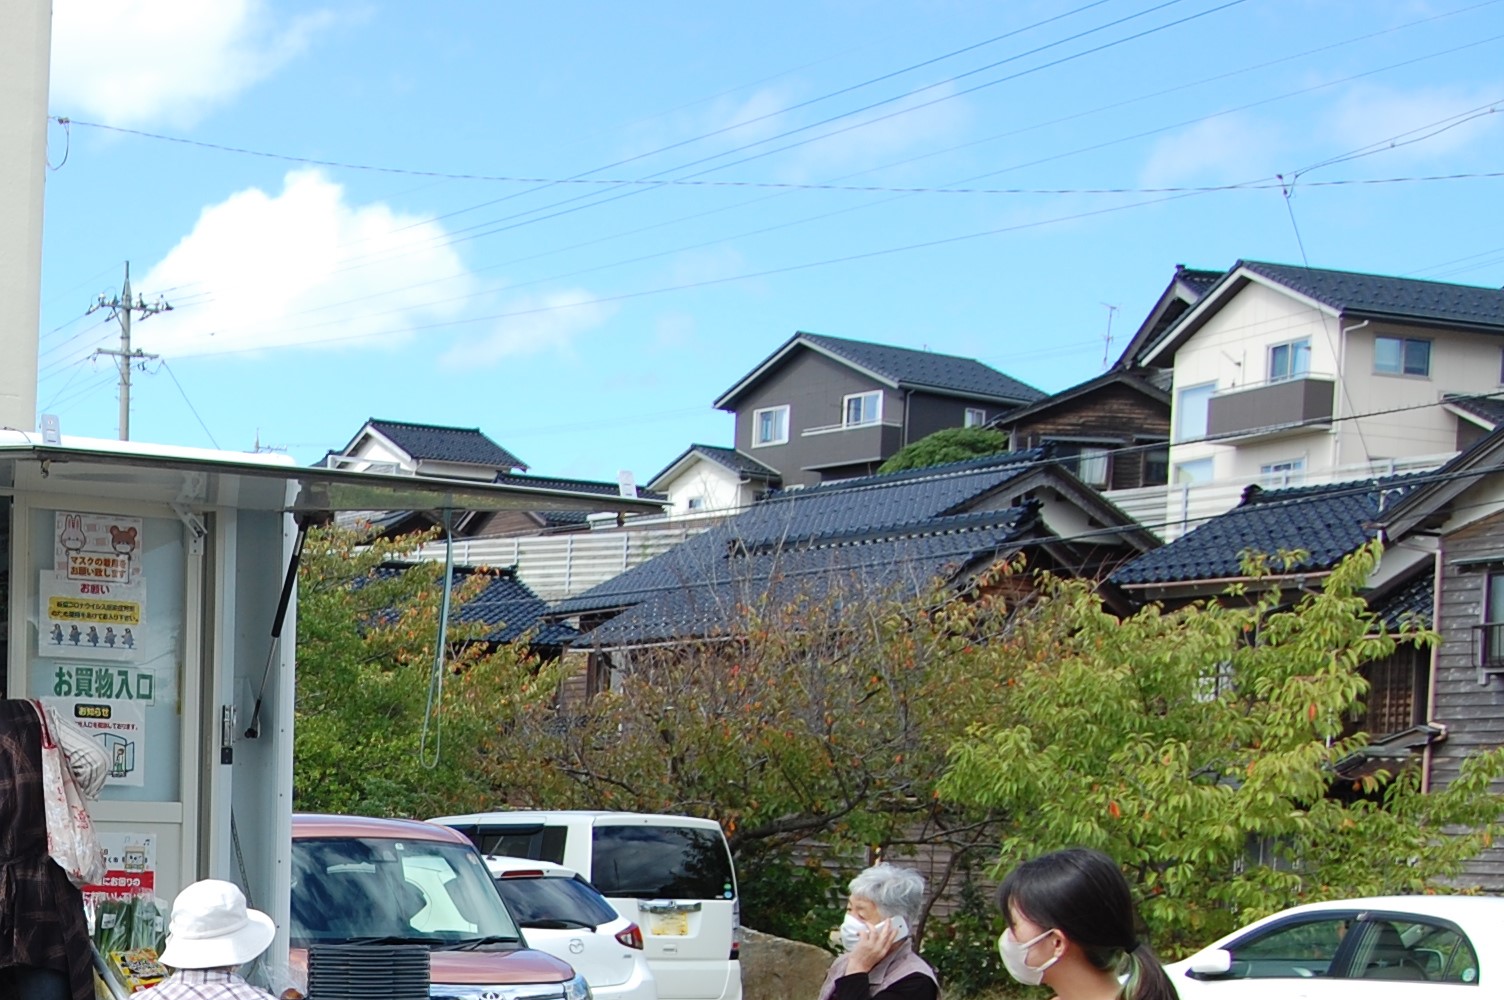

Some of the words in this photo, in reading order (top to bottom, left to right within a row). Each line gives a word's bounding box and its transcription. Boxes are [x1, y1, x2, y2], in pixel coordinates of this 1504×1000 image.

[80, 583, 111, 595] お願い
[53, 666, 154, 700] お買物入口
[78, 707, 110, 717] お知らせ
